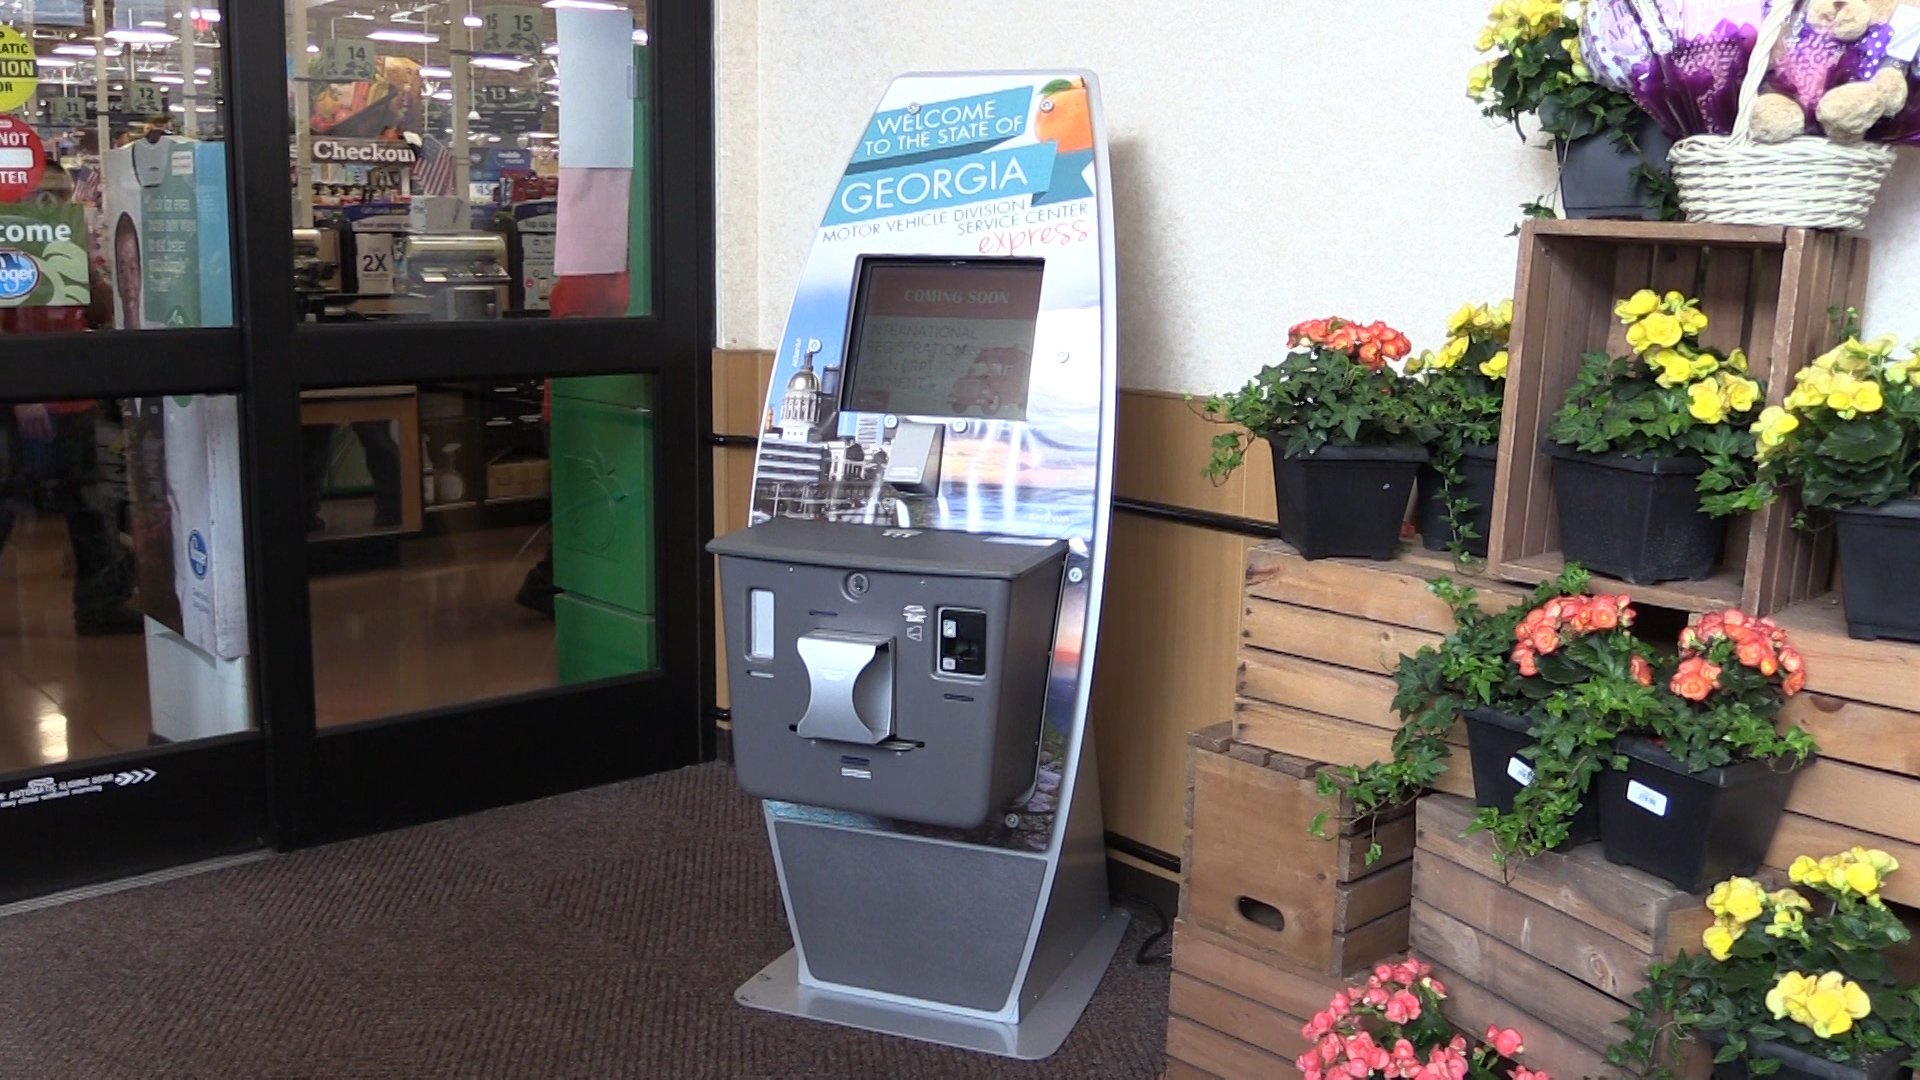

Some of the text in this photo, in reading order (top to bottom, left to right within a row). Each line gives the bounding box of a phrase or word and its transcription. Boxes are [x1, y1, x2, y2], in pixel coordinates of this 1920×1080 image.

[513, 14, 533, 32] 15
[347, 45, 367, 61] 14
[139, 87, 155, 100] 12
[491, 87, 506, 100] 13
[66, 102, 79, 112] 11
[877, 100, 996, 135] WELCOME
[0, 131, 30, 146] NOT
[864, 115, 1023, 156] TO THE STATE OF
[841, 156, 1028, 214] GEORGIA
[822, 200, 1025, 244] MOTOR VEHICLE DIVISION
[957, 203, 1088, 236] SERVICE CENTER
[978, 219, 1089, 256] express
[362, 253, 388, 272] 2X
[904, 289, 1010, 304] COMING SOON
[870, 321, 978, 341] INTERNATIONAL
[866, 340, 969, 357] REGISTRATION
